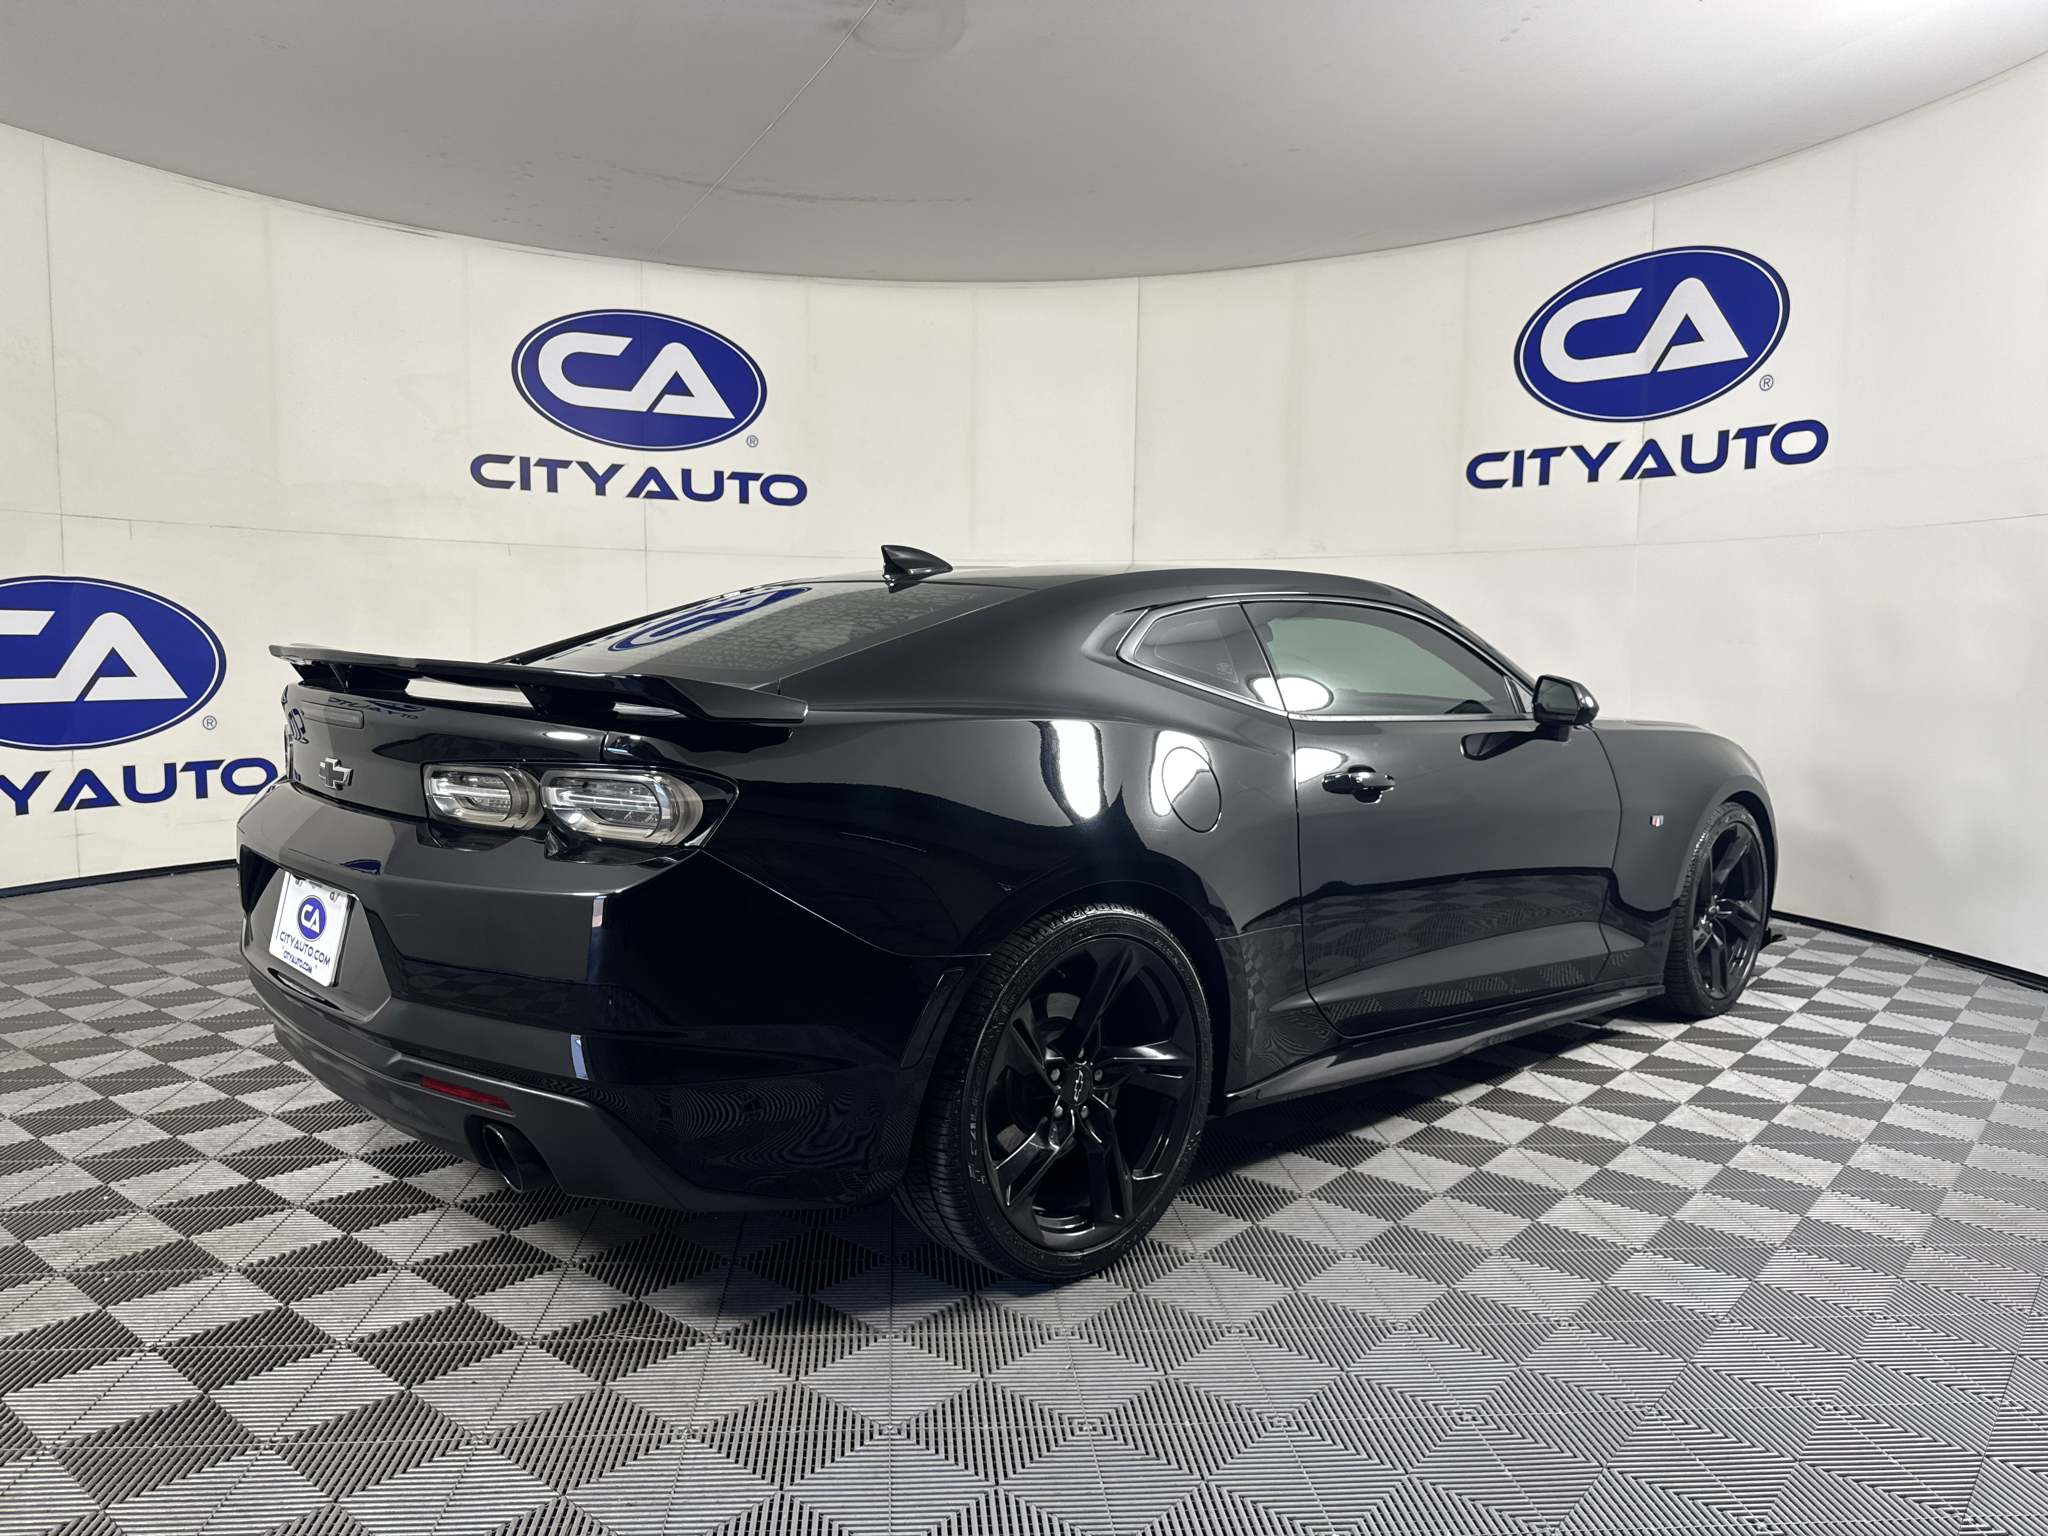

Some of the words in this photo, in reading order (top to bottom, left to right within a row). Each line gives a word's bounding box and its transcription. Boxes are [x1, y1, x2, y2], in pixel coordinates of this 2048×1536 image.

[1540, 277, 1749, 383] CA
[538, 332, 735, 419] CA
[279, 931, 331, 967] CITYAUTO.COM
[300, 903, 320, 934] CA
